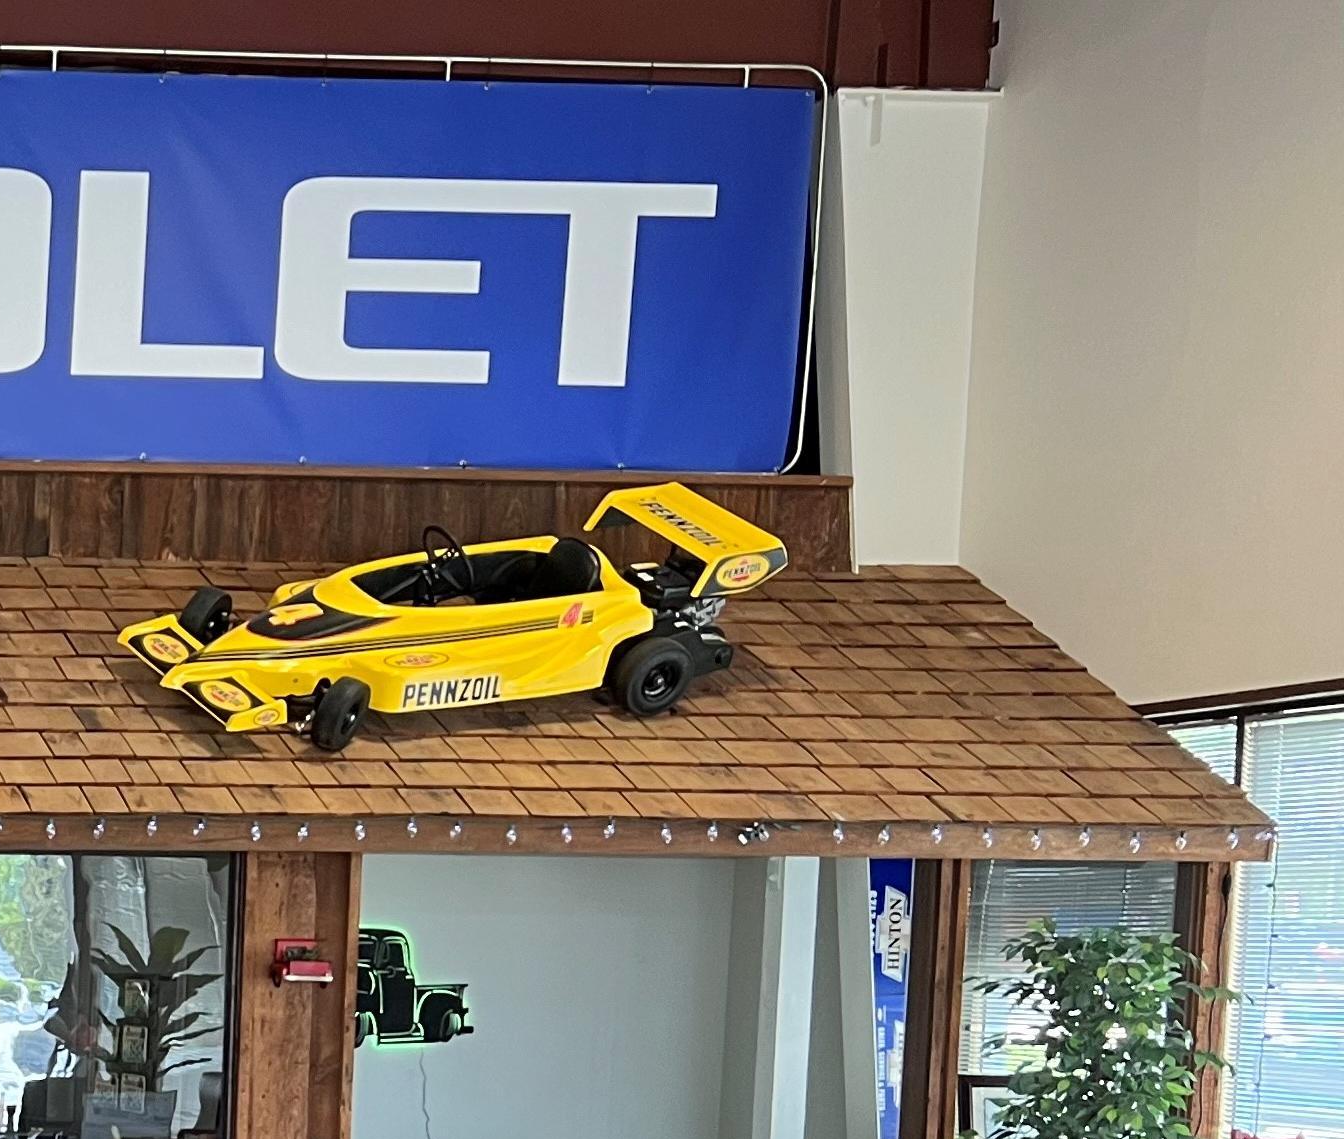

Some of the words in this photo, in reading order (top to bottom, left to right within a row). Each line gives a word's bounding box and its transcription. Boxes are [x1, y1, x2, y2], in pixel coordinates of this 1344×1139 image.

[641, 500, 722, 547] PENNZOIL
[723, 562, 761, 579] PENNZOIL
[269, 603, 324, 625] 4
[562, 602, 583, 628] 4
[402, 675, 501, 708] PENNZOIL
[887, 898, 902, 969] HINTON
